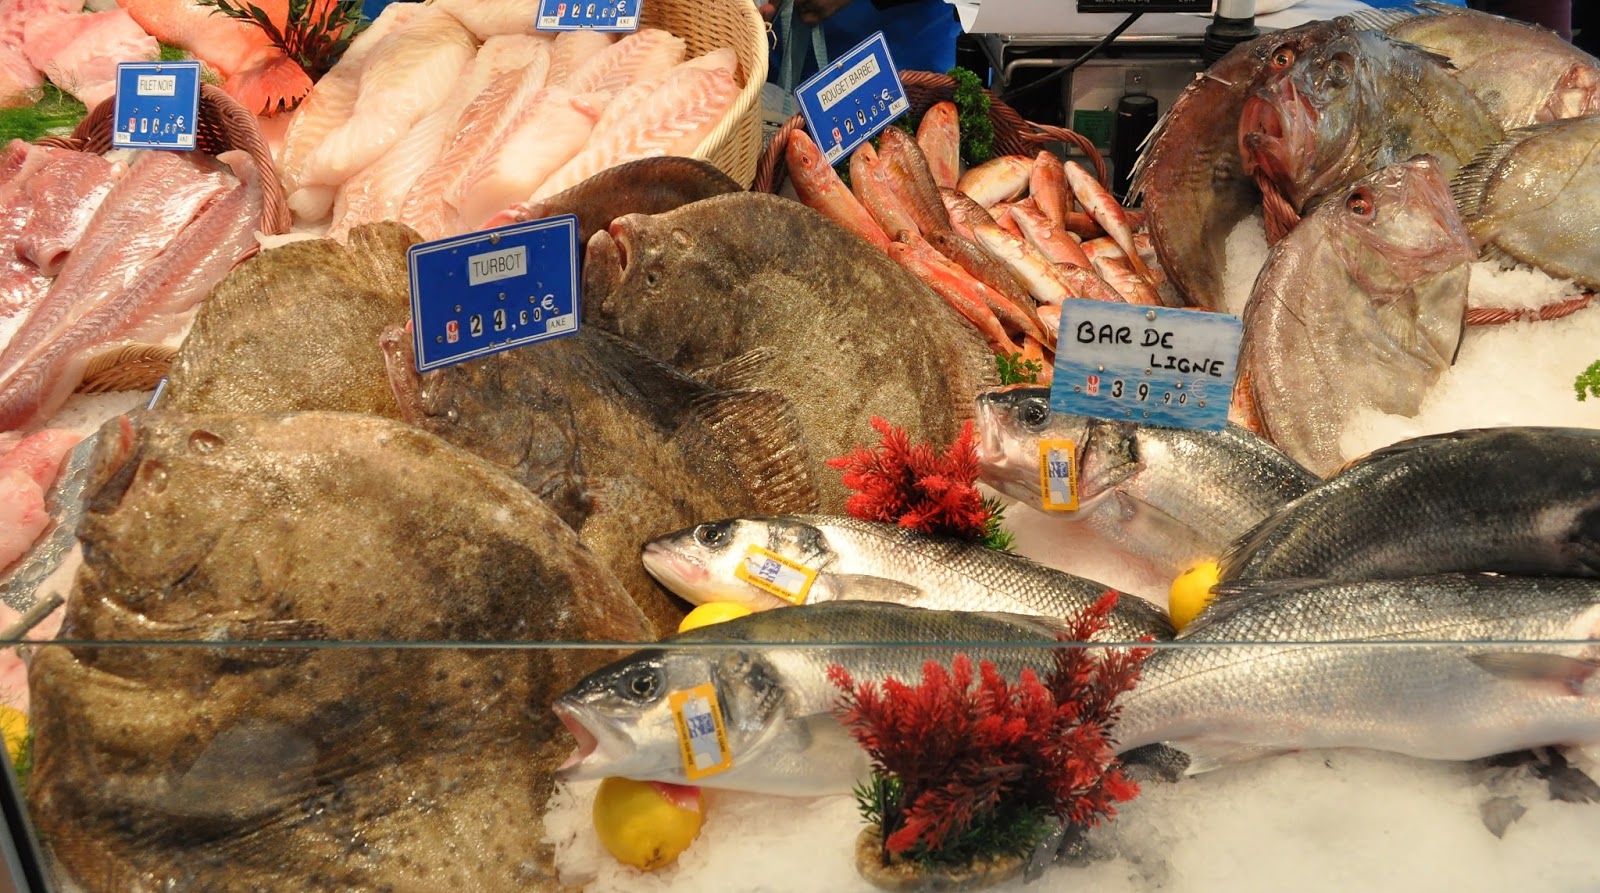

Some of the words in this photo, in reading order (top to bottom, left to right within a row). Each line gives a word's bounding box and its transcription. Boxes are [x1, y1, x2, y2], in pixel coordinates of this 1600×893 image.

[140, 79, 157, 91] FILET
[158, 80, 173, 91] NOIR
[820, 77, 849, 105] ROUGET
[848, 58, 877, 85] BARBET
[472, 253, 522, 277] TURBOT
[1077, 320, 1132, 344] BAR
[1140, 328, 1174, 349] DE
[1150, 353, 1225, 377] LIGNE
